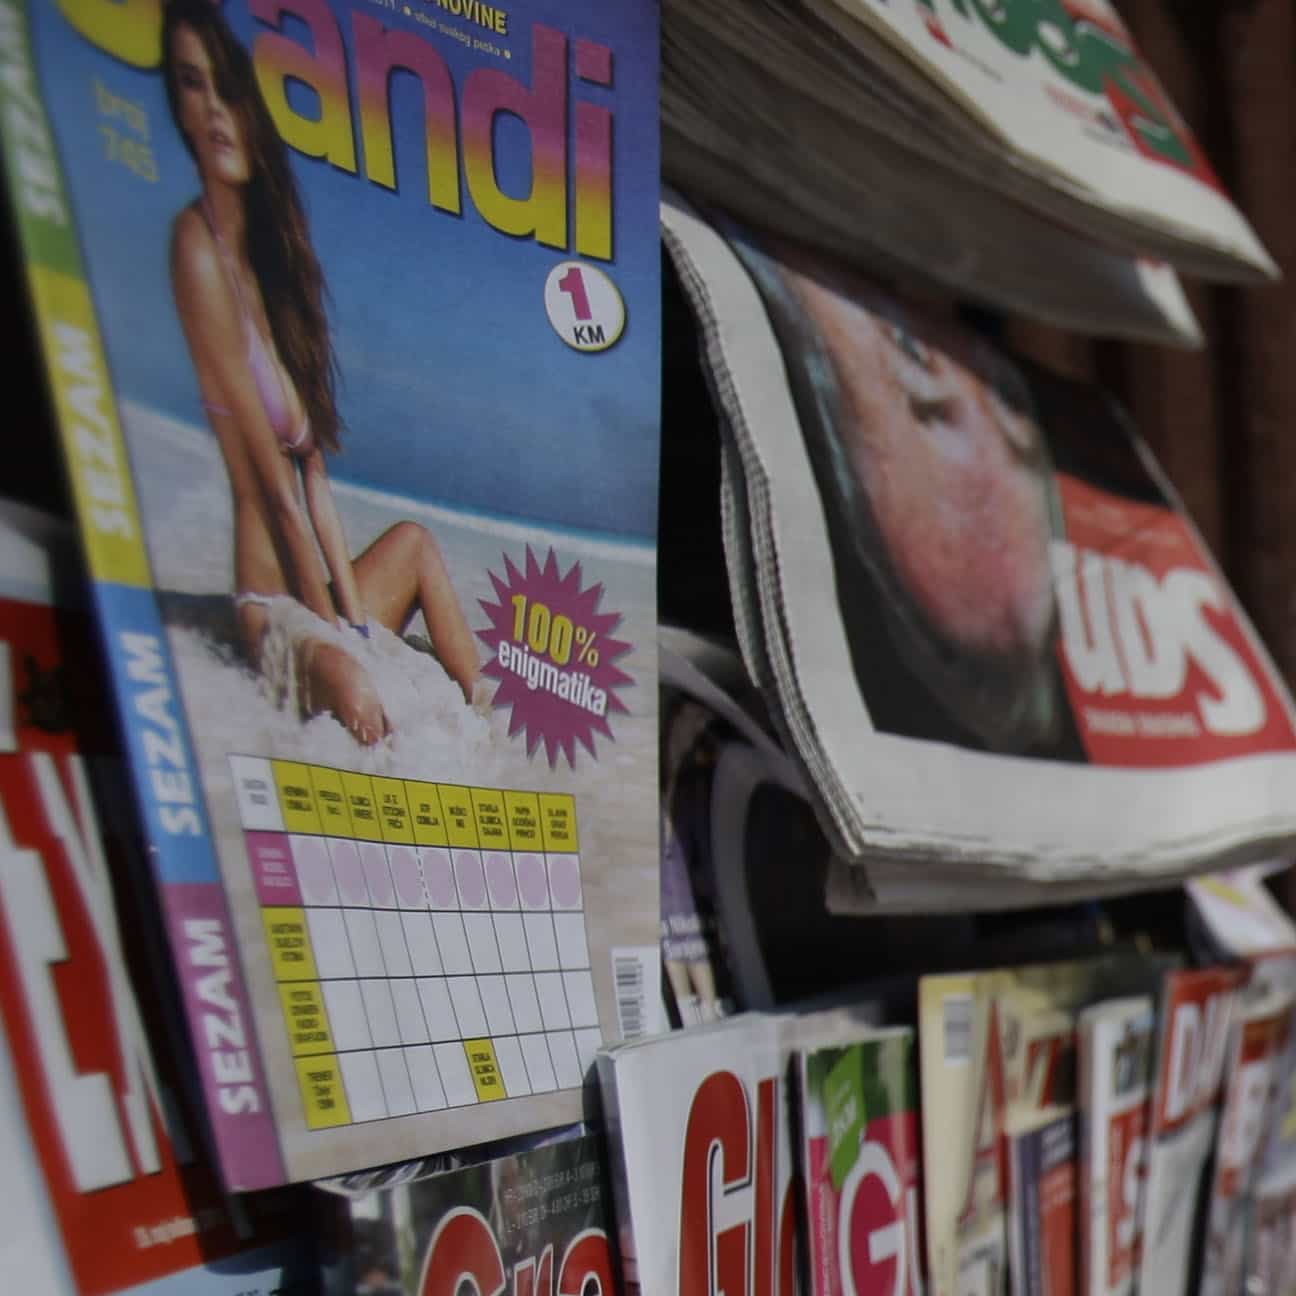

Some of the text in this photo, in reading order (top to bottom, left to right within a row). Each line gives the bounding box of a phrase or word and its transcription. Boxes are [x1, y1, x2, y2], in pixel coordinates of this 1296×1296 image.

[558, 266, 592, 321] 1
[573, 325, 606, 345] KM
[52, 321, 133, 542] SEZAM
[498, 639, 608, 717] enigmatika
[511, 593, 600, 668] 100%
[1048, 538, 1268, 737] San
[121, 630, 202, 839] SEZAM
[182, 918, 260, 1116] SEZAM
